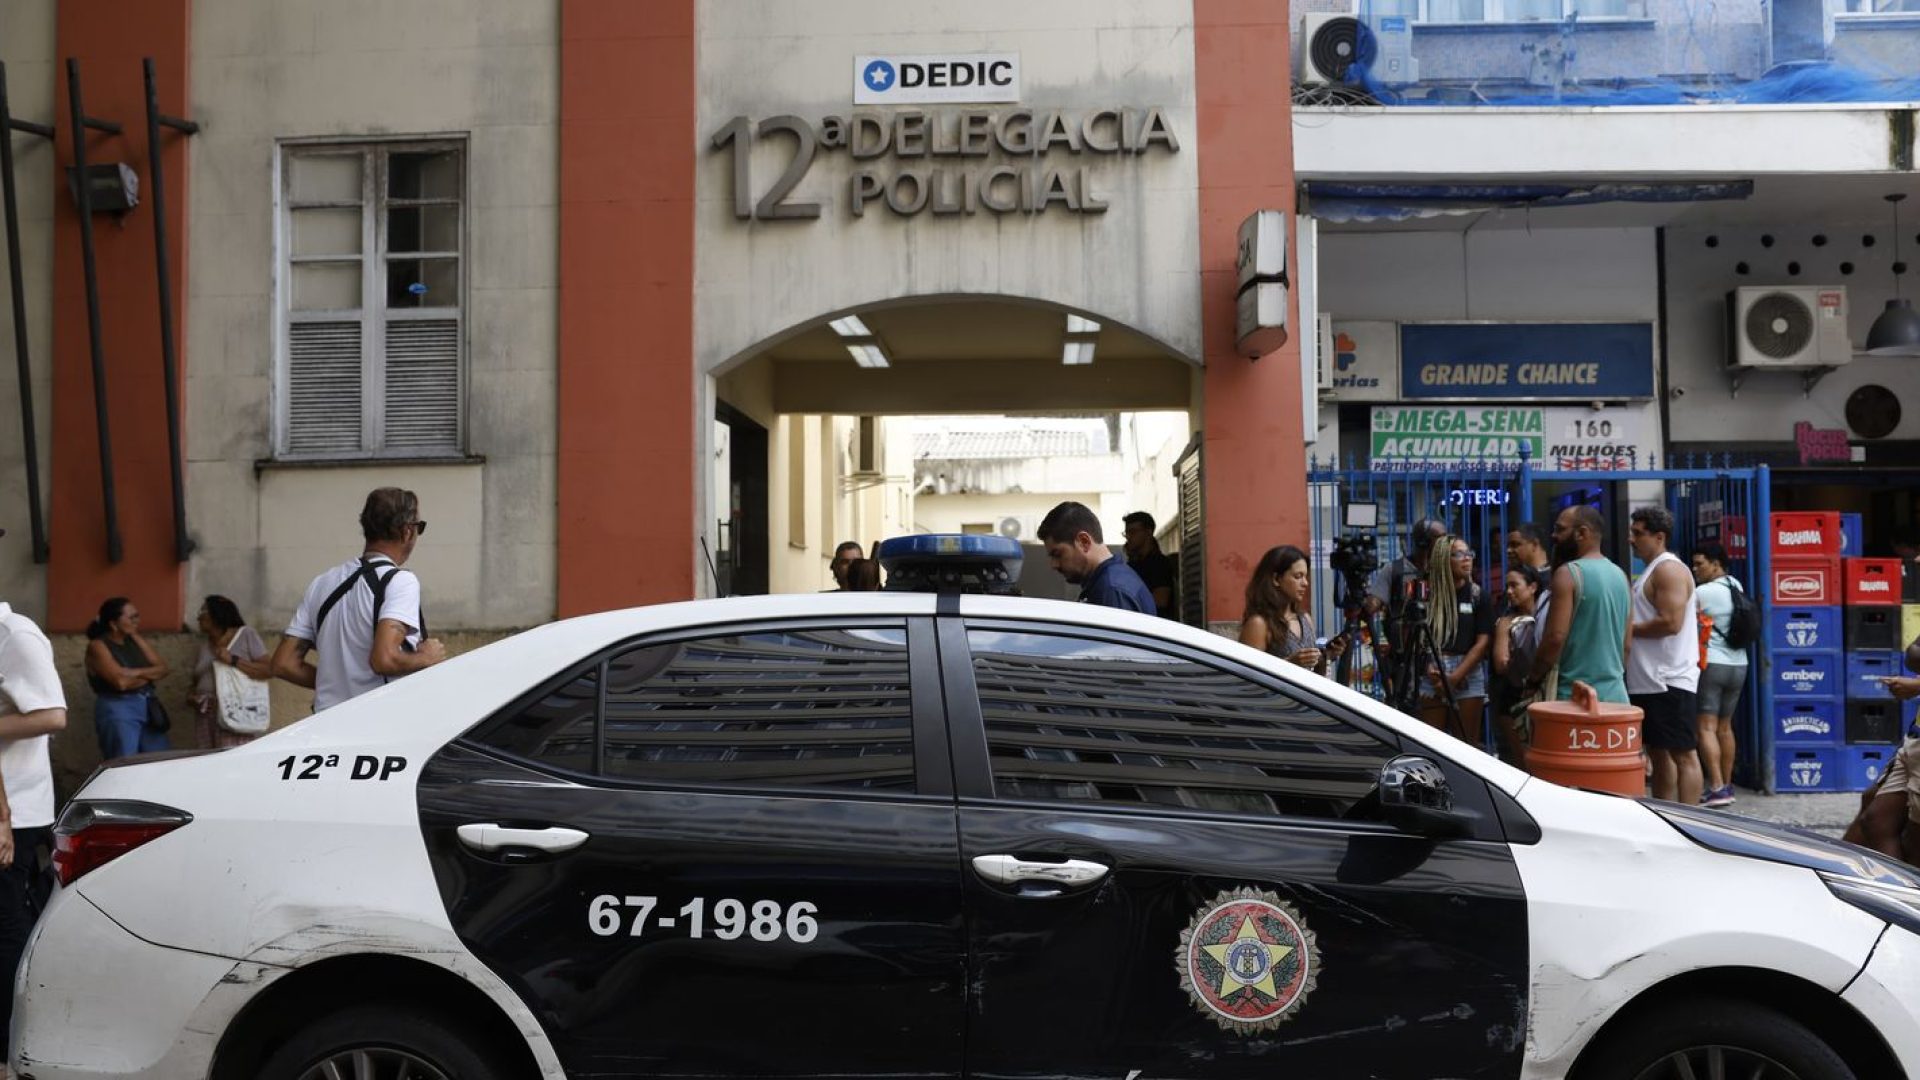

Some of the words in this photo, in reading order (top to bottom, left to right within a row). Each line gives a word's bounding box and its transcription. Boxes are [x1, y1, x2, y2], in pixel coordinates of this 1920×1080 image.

[900, 60, 1013, 88] DEDIC
[851, 107, 1181, 160] DELEGACIA
[851, 164, 1109, 217] POLICIAL
[1420, 363, 1509, 385] GRANDE
[1517, 363, 1599, 385] CHANCE
[1395, 409, 1543, 432] MEGA-SENA
[1574, 420, 1612, 438] 160
[1550, 442, 1637, 456] MILHÕES
[1778, 530, 1821, 545] BRAHMA
[1786, 621, 1818, 630] ambev
[1781, 669, 1824, 681] ambev
[1568, 728, 1600, 749] 12
[350, 755, 407, 780] DP
[588, 894, 818, 943] 67-1986
